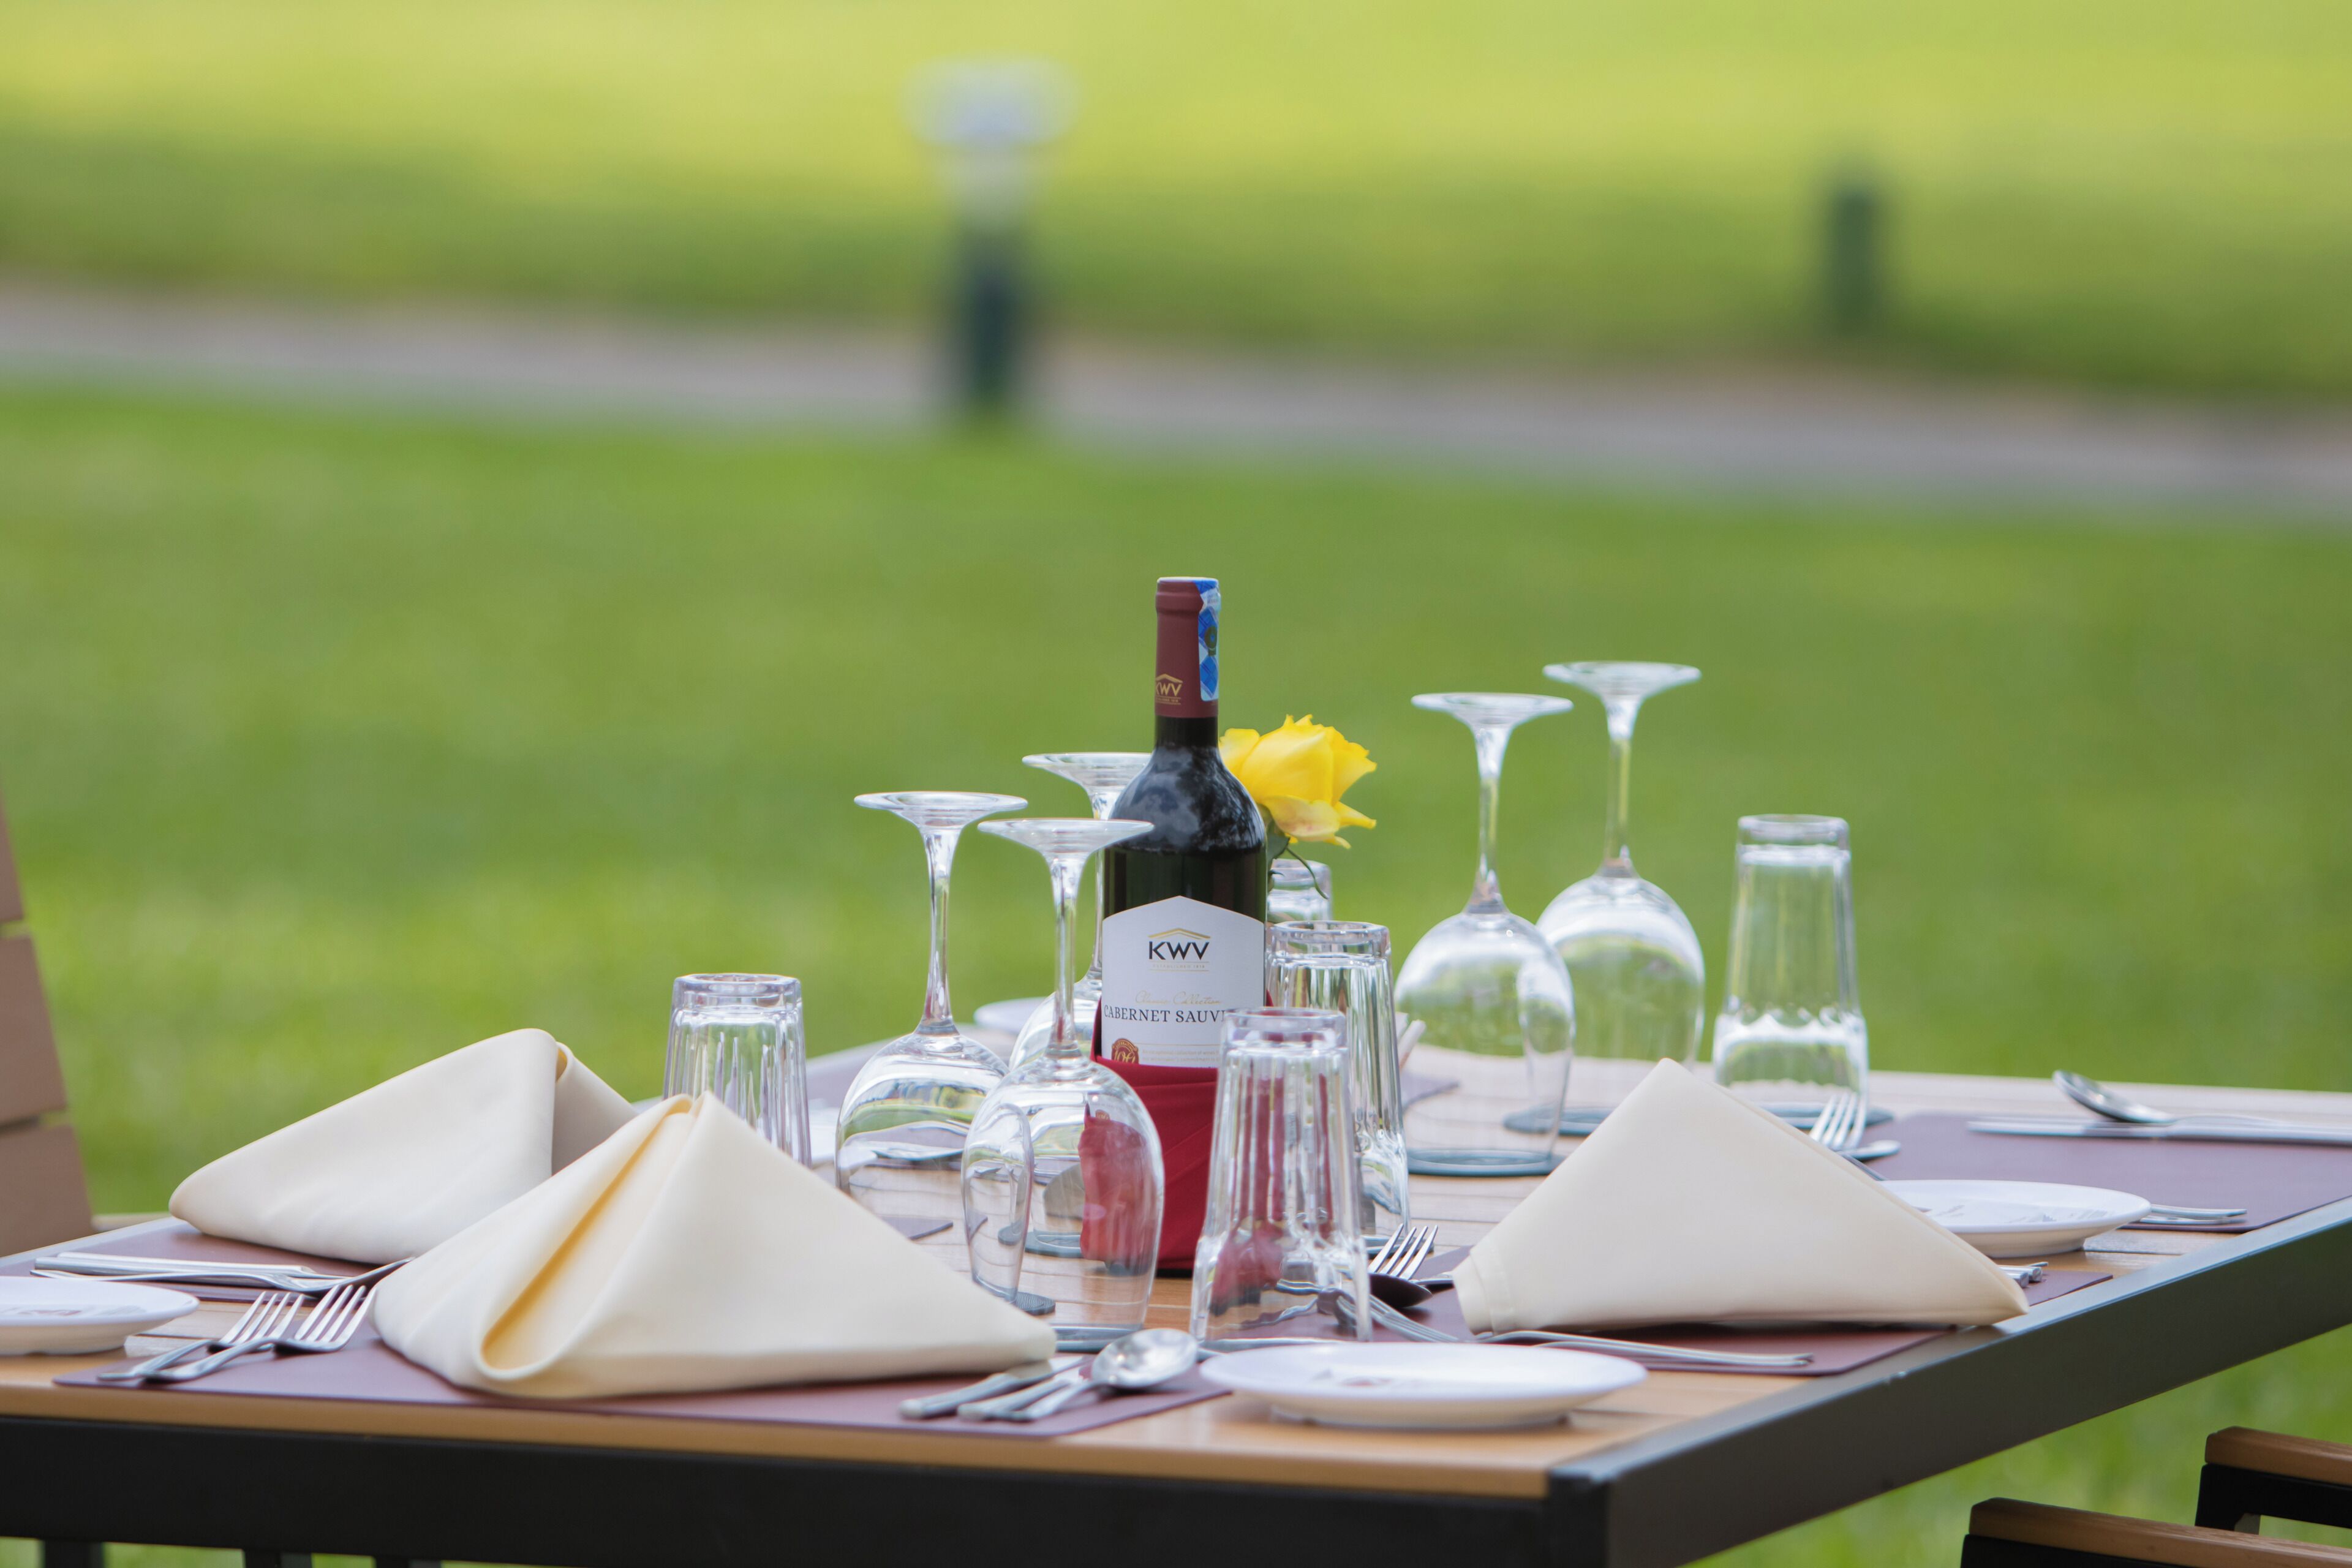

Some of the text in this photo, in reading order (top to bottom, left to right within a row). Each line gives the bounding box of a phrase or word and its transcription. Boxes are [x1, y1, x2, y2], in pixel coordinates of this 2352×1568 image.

[1148, 941, 1210, 960] KWV
[1104, 1005, 1226, 1023] CABERNET SAUVI
